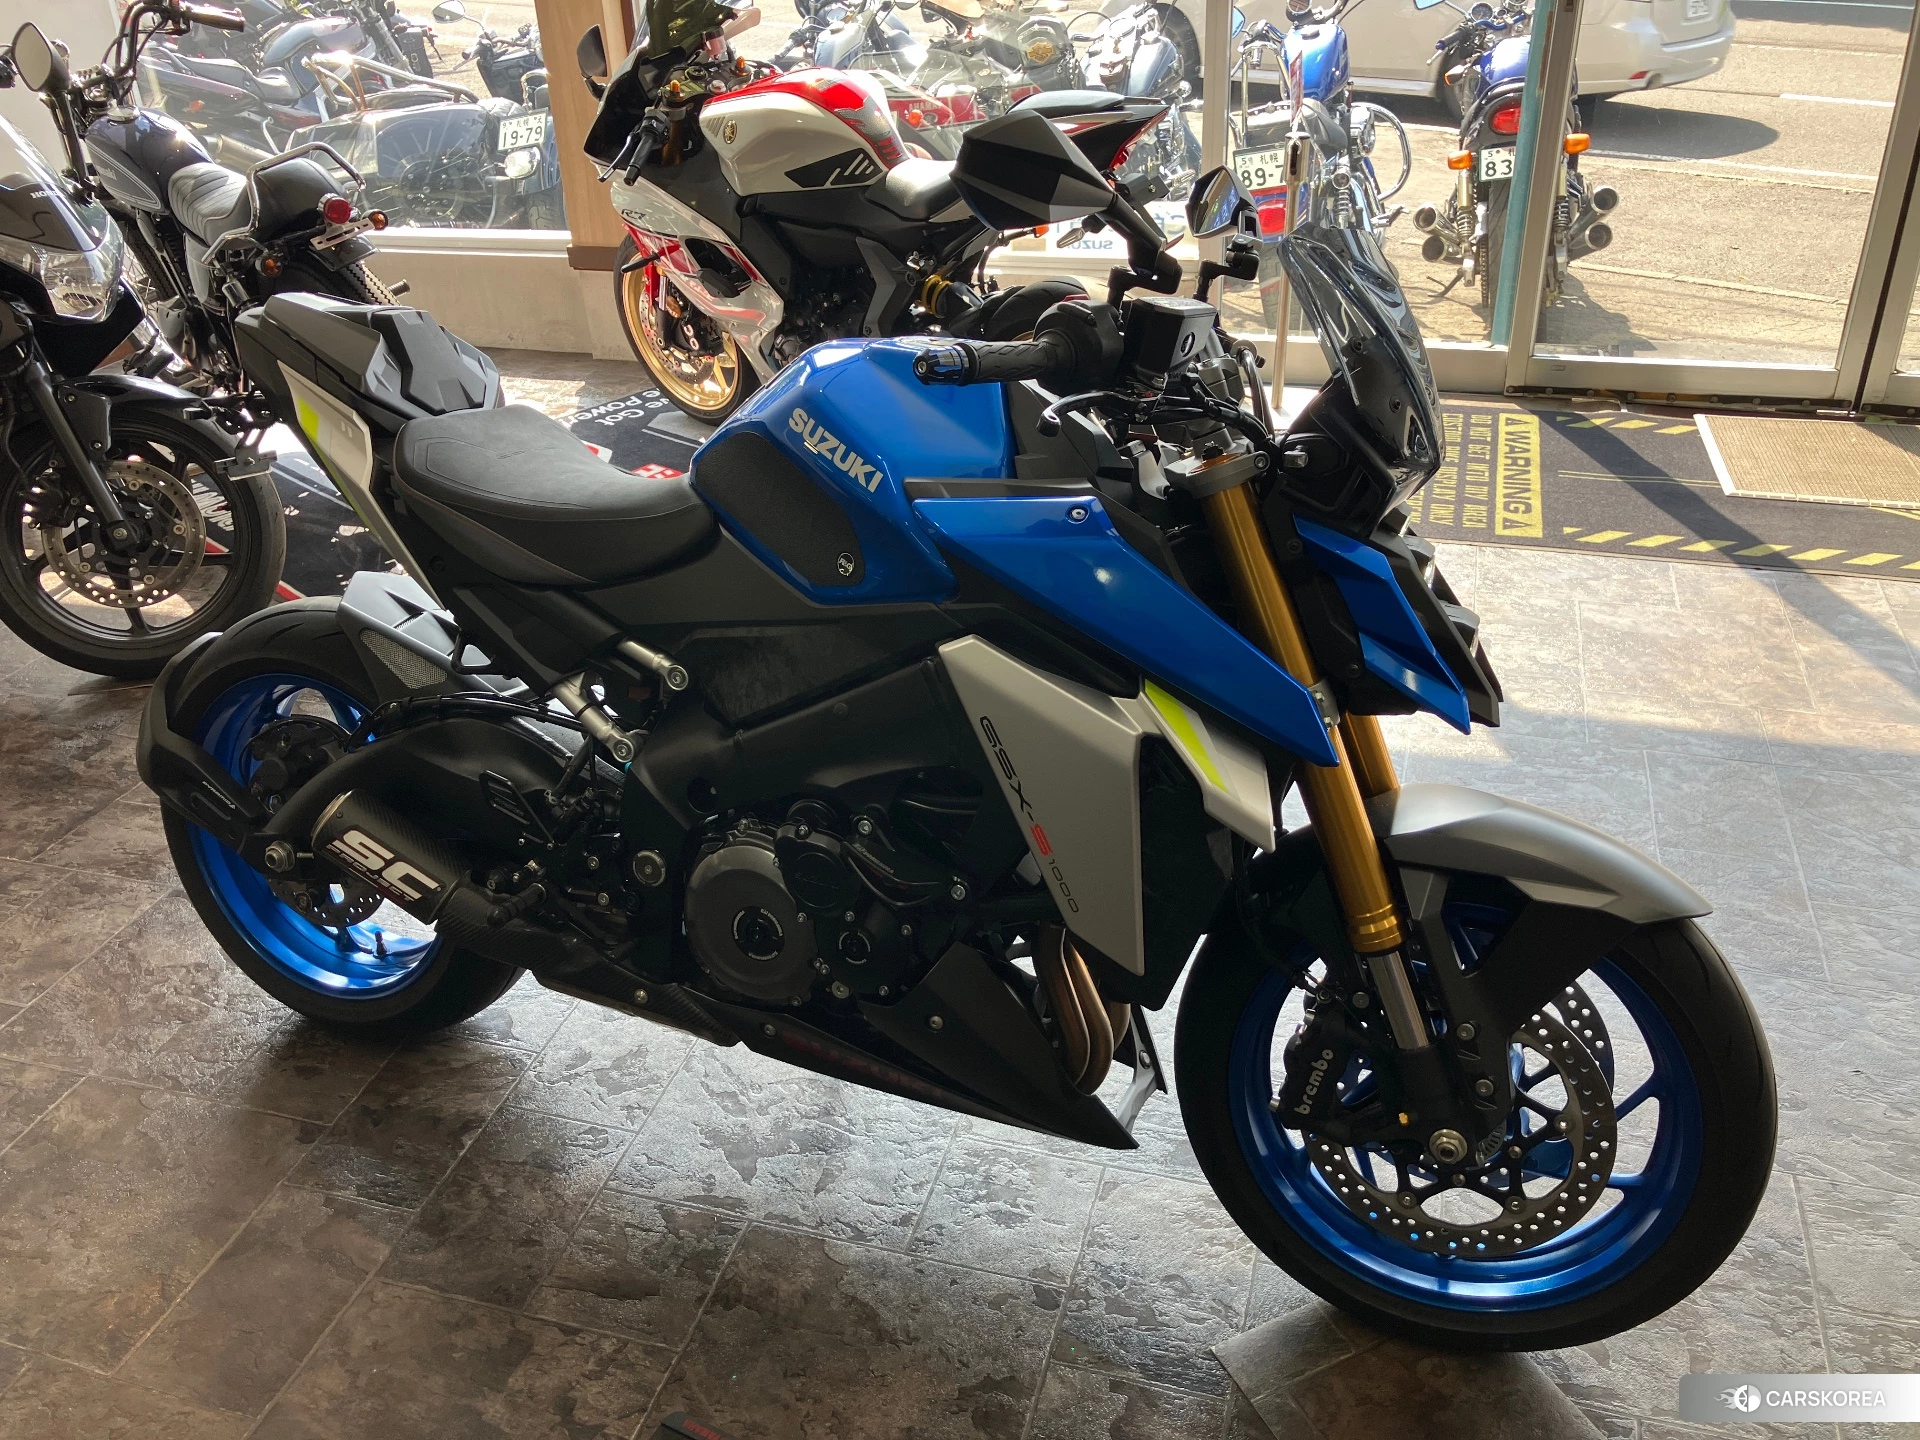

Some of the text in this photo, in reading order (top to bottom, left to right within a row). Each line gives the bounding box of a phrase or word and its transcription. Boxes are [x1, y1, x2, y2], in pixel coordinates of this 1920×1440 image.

[502, 125, 543, 148] 19-79
[1241, 164, 1284, 188] 89-7
[788, 407, 884, 494] SUZUKI
[1462, 414, 1493, 528] DO NOT GET INTO MY AREA
[1503, 430, 1533, 515] WARNING
[1428, 503, 1456, 526] ONLY
[325, 843, 415, 902] PROJECT
[331, 829, 441, 901] SC
[1293, 1049, 1334, 1115] brembo
